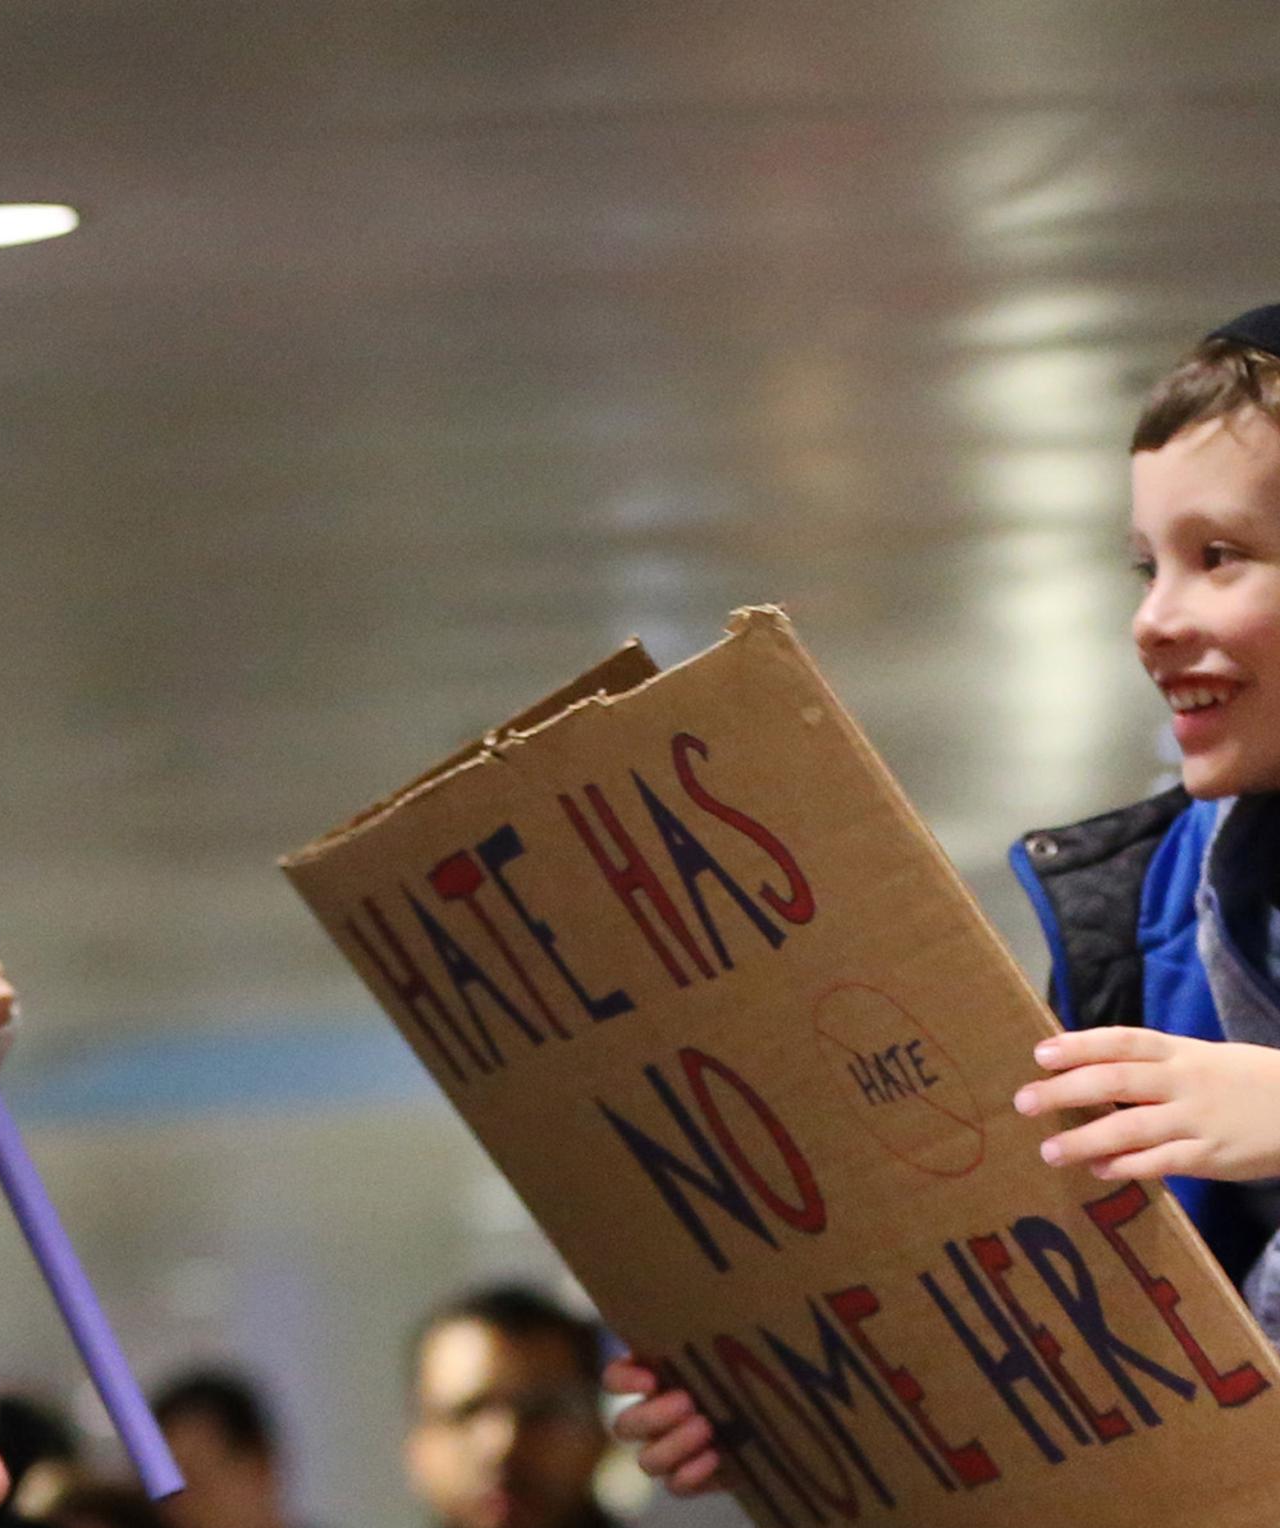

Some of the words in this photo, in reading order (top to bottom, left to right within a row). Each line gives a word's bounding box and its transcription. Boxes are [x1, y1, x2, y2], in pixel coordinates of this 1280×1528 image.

[346, 824, 636, 1083] HATE
[556, 732, 817, 990] HAS
[592, 1046, 828, 1274] NO
[846, 1039, 940, 1107] HATE
[918, 1179, 1272, 1466] HERE
